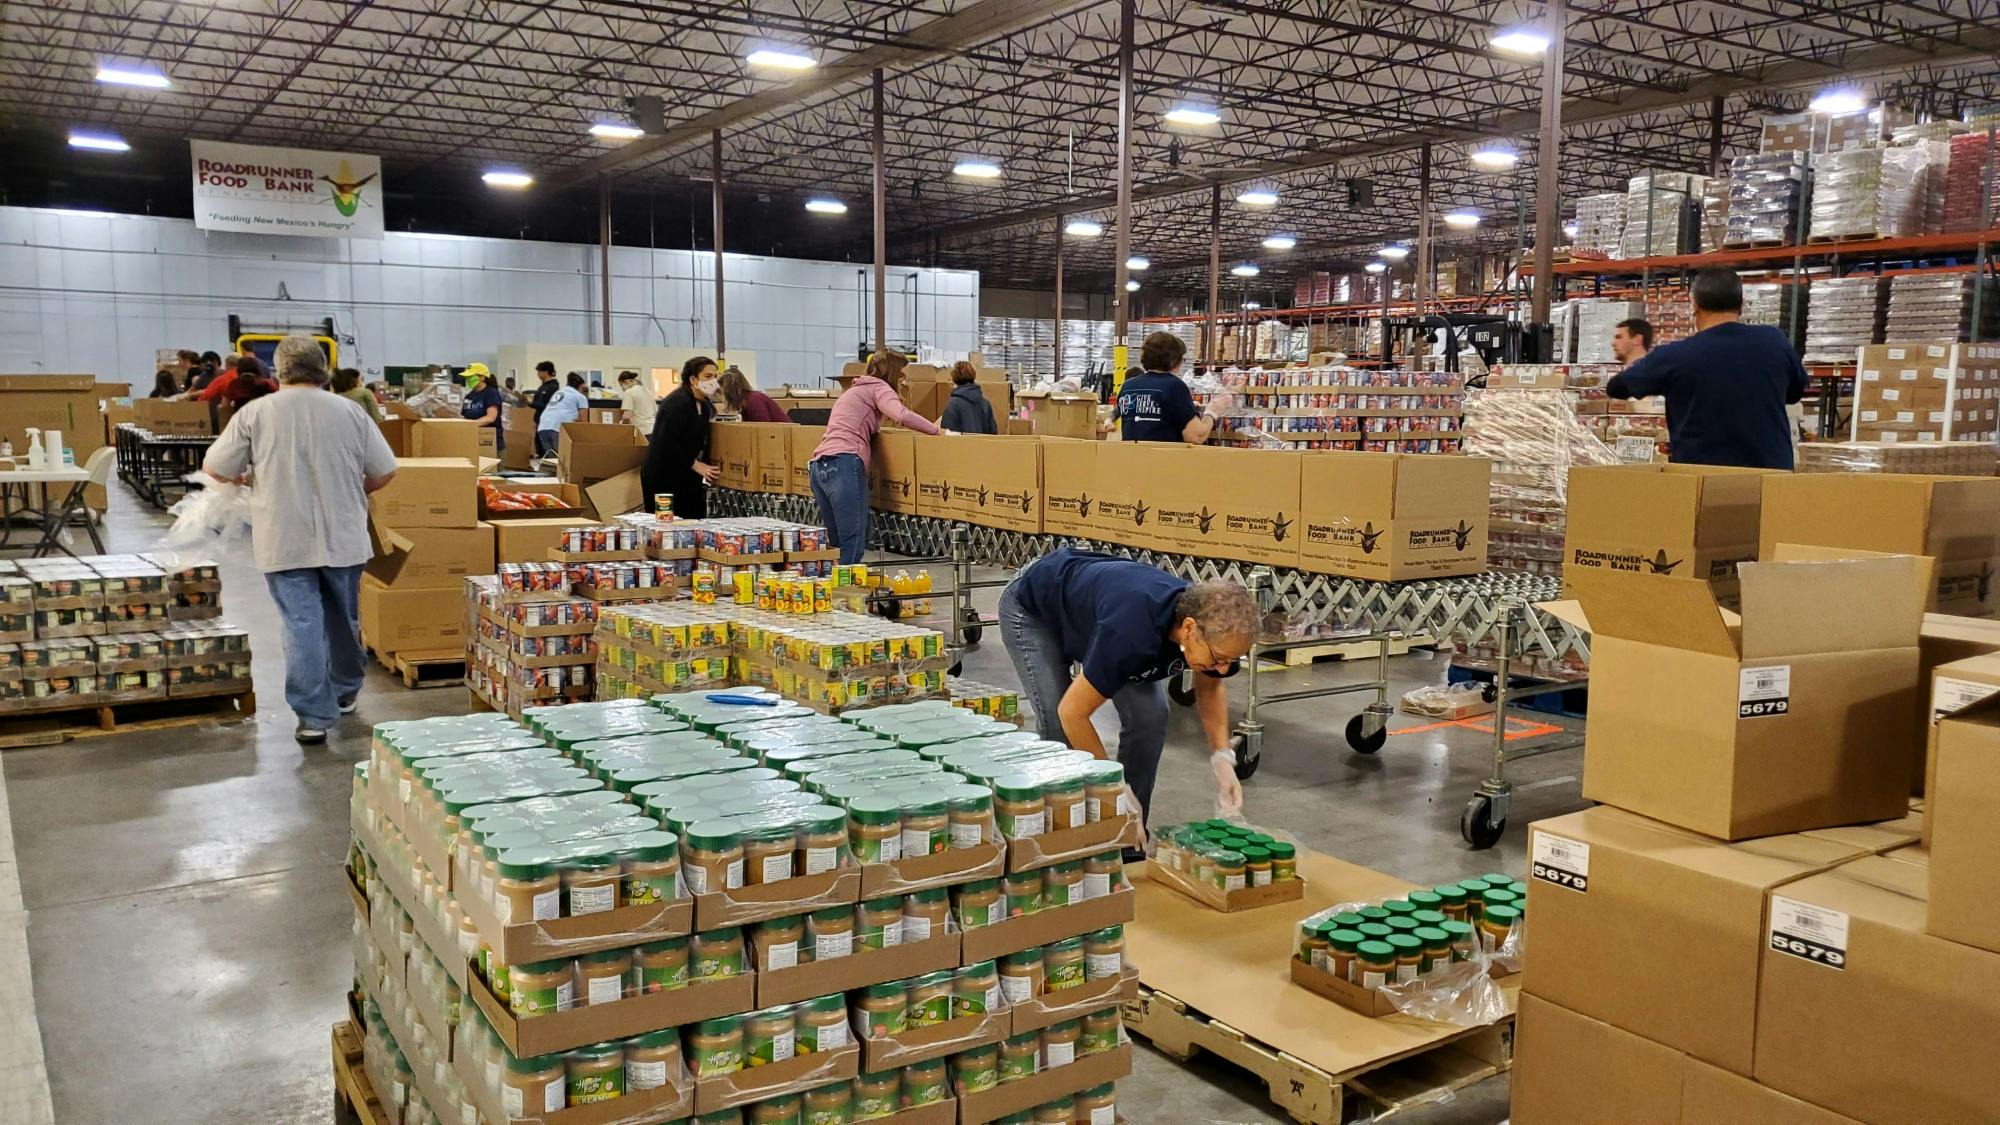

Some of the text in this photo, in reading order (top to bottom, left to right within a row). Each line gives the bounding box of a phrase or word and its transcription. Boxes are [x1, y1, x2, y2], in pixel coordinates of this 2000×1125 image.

[198, 158, 314, 180] ROADRUNNER
[199, 172, 315, 193] FOOD BANK
[253, 217, 273, 225] New
[276, 217, 316, 228] Mexico's
[1476, 332, 1489, 341] 102
[1227, 514, 1268, 524] ROADRUNNER
[1248, 523, 1268, 531] BANK
[1308, 524, 1355, 535] ROADRUNNER
[1410, 529, 1451, 537] ROADRUNNER
[1308, 530, 1355, 542] FOOD BANK
[1409, 536, 1450, 545] FOOD BANK
[1575, 549, 1642, 564] ROADRUNNER
[1574, 557, 1641, 572] FOOD BANK
[1740, 701, 1788, 715] 5679
[1534, 864, 1587, 889] 5679
[1771, 934, 1844, 965] 5679
